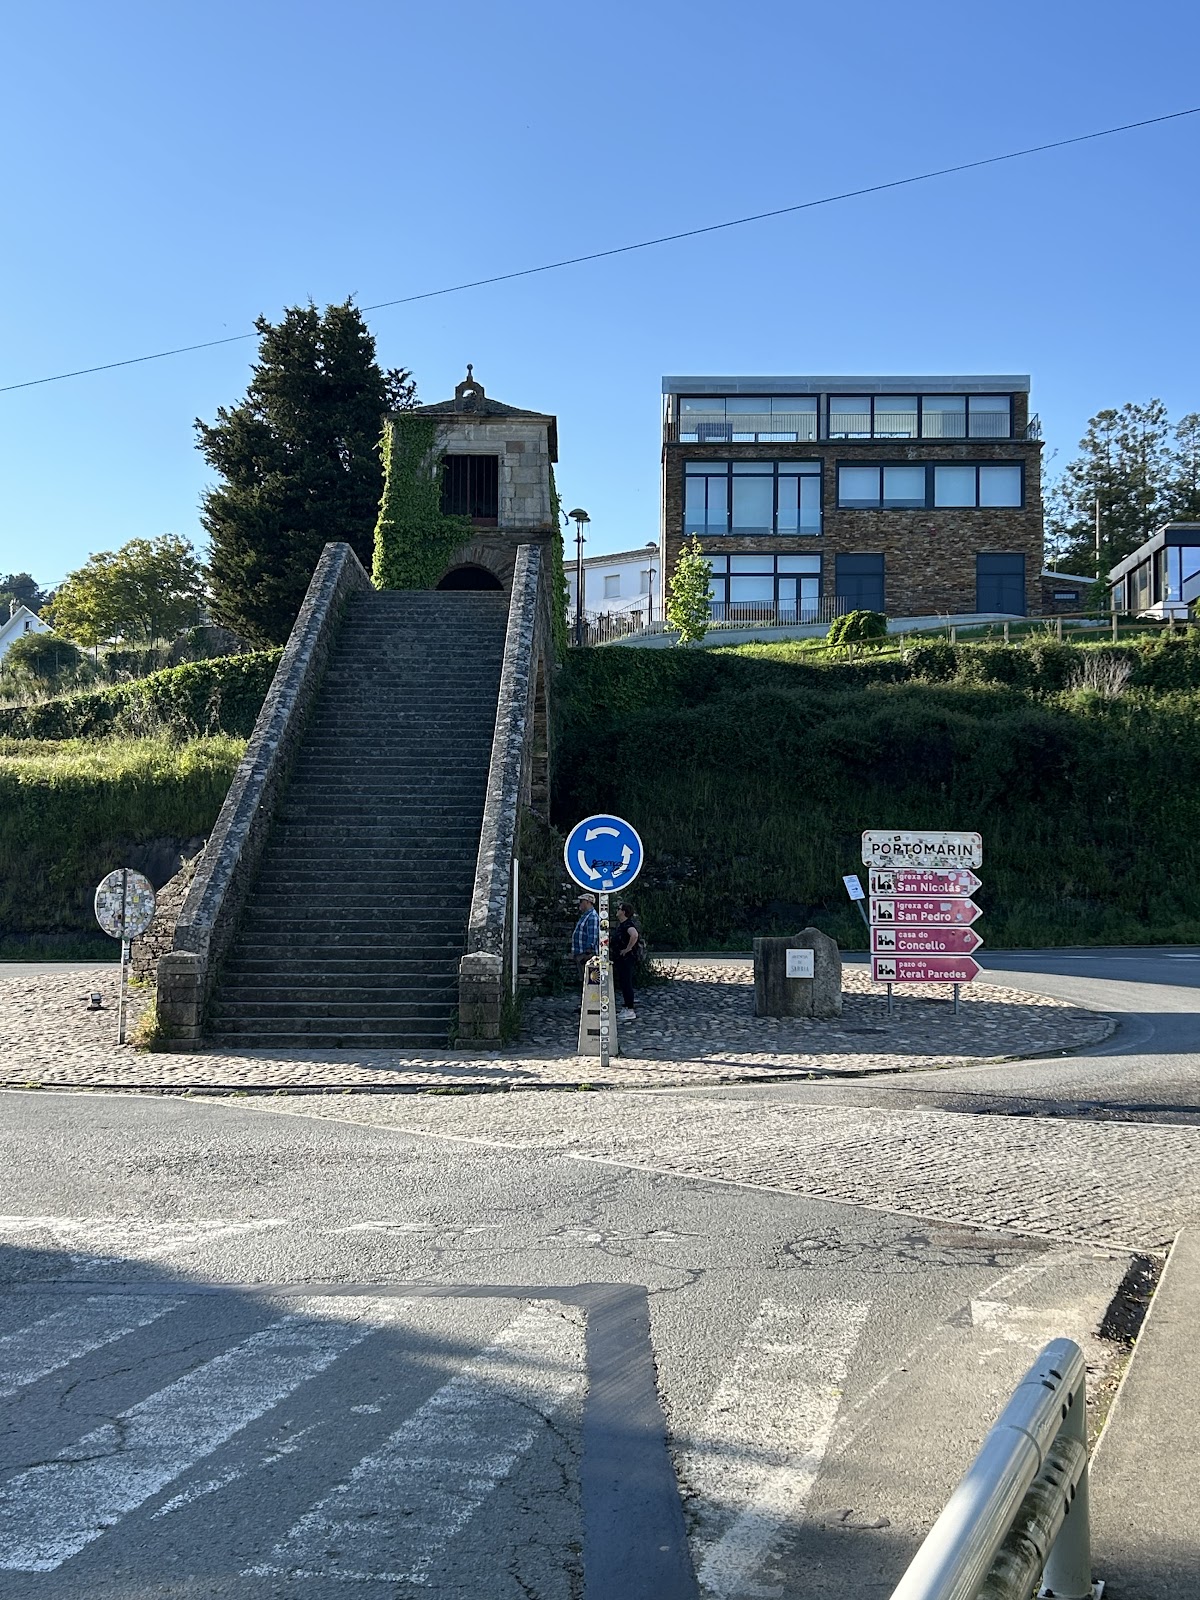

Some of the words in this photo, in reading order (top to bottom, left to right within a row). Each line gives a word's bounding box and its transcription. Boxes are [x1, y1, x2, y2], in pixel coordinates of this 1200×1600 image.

[872, 843, 973, 856] PORTOMARIN
[897, 882, 917, 891] San
[920, 882, 961, 892] Nicolás
[897, 911, 917, 921] San
[921, 911, 951, 921] Pedro
[898, 940, 946, 950] Concello
[899, 969, 925, 978] Xeral
[928, 969, 967, 979] Paredes
